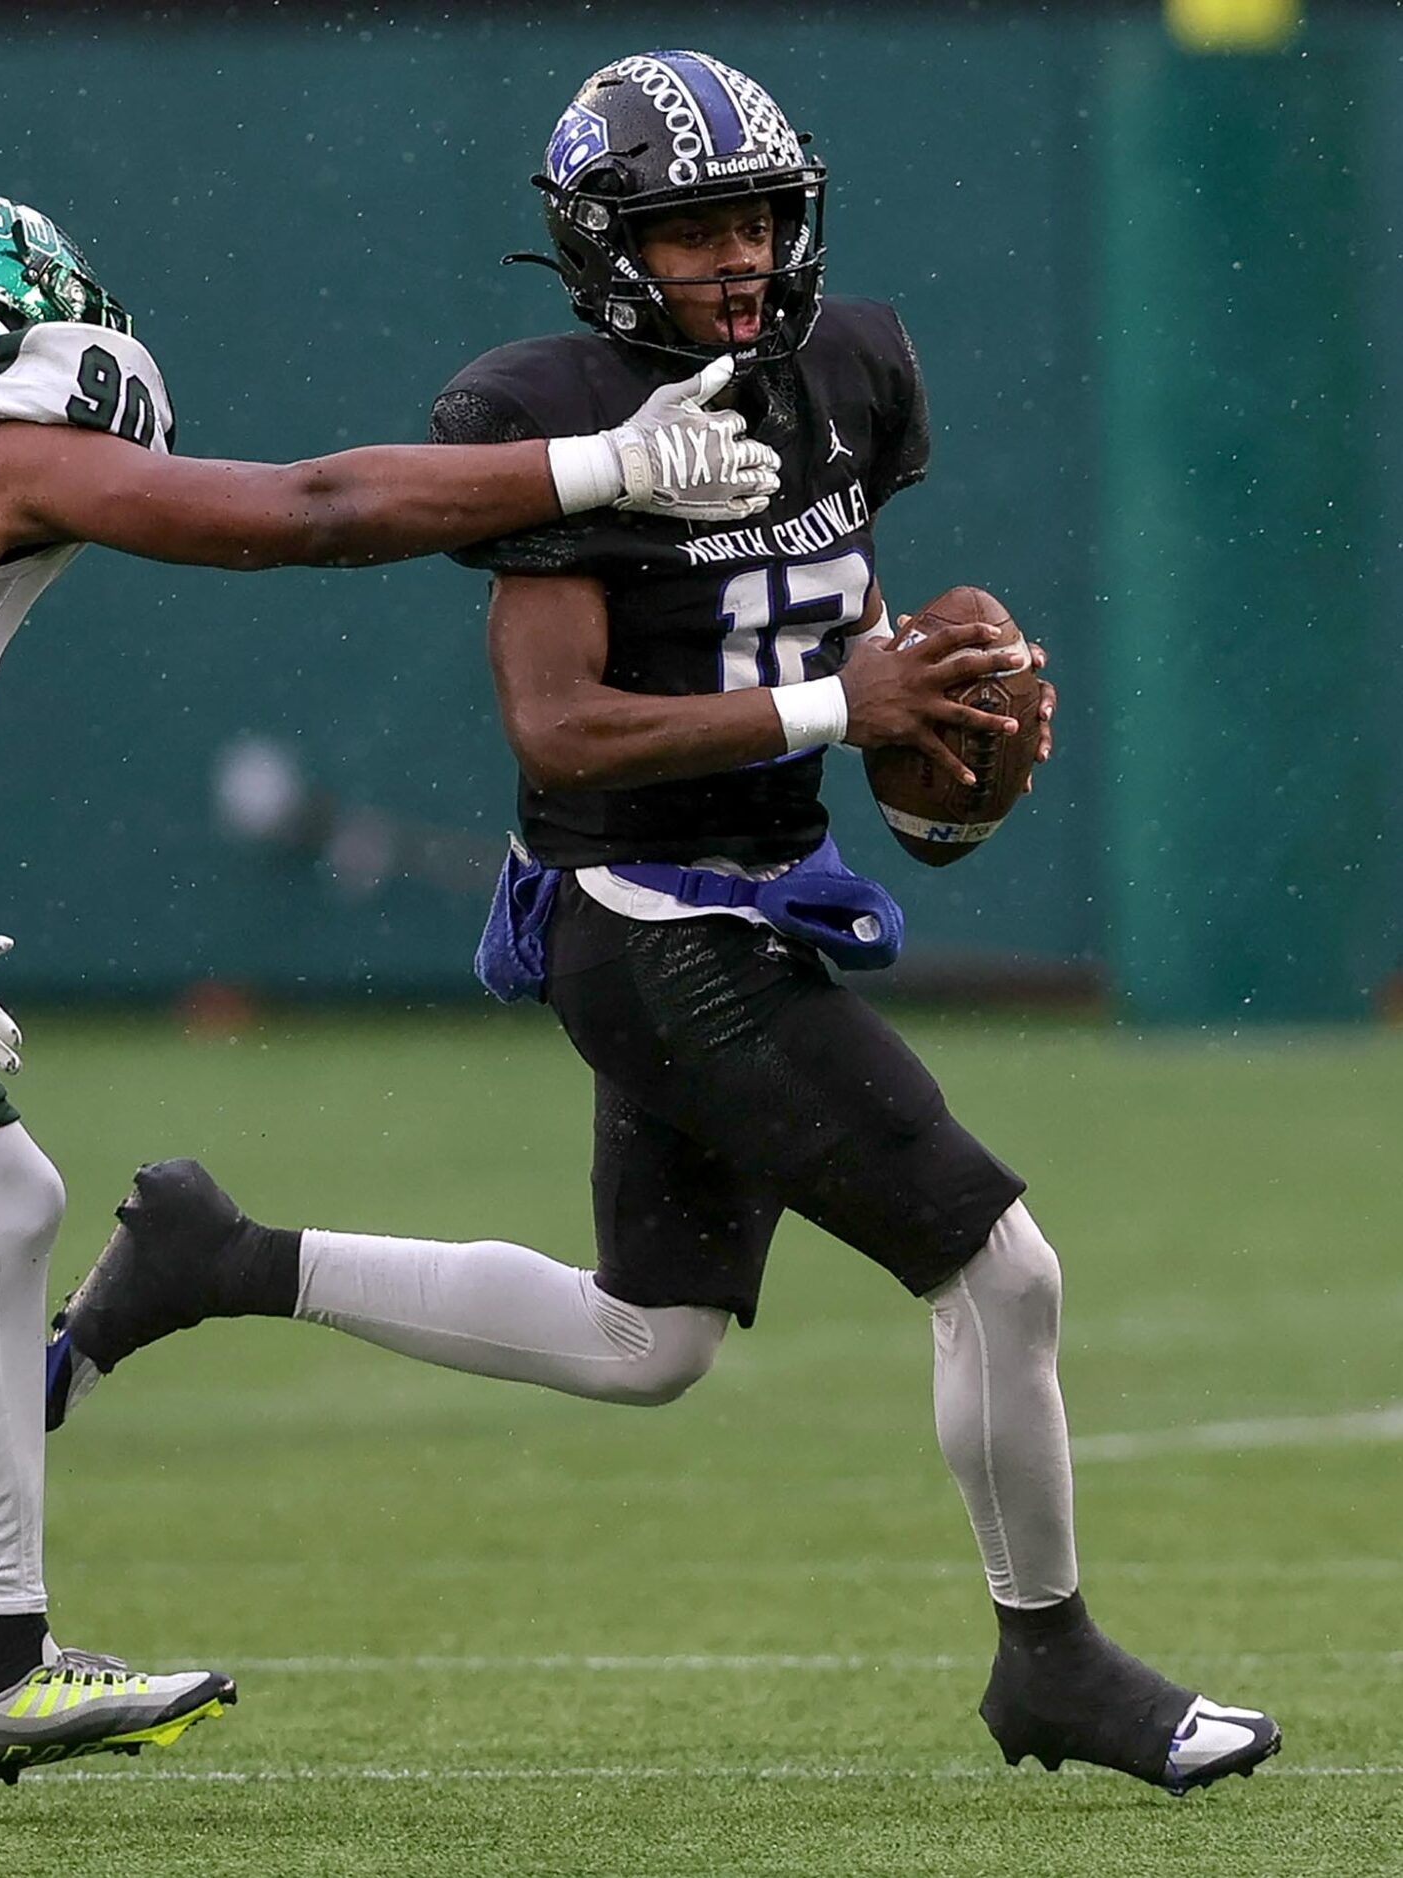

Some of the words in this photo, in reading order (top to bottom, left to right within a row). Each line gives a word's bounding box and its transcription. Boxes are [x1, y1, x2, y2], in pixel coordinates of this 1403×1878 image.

[706, 153, 769, 177] Riddell
[65, 344, 156, 449] 90
[676, 527, 775, 566] NORTH
[716, 548, 875, 698] 12
